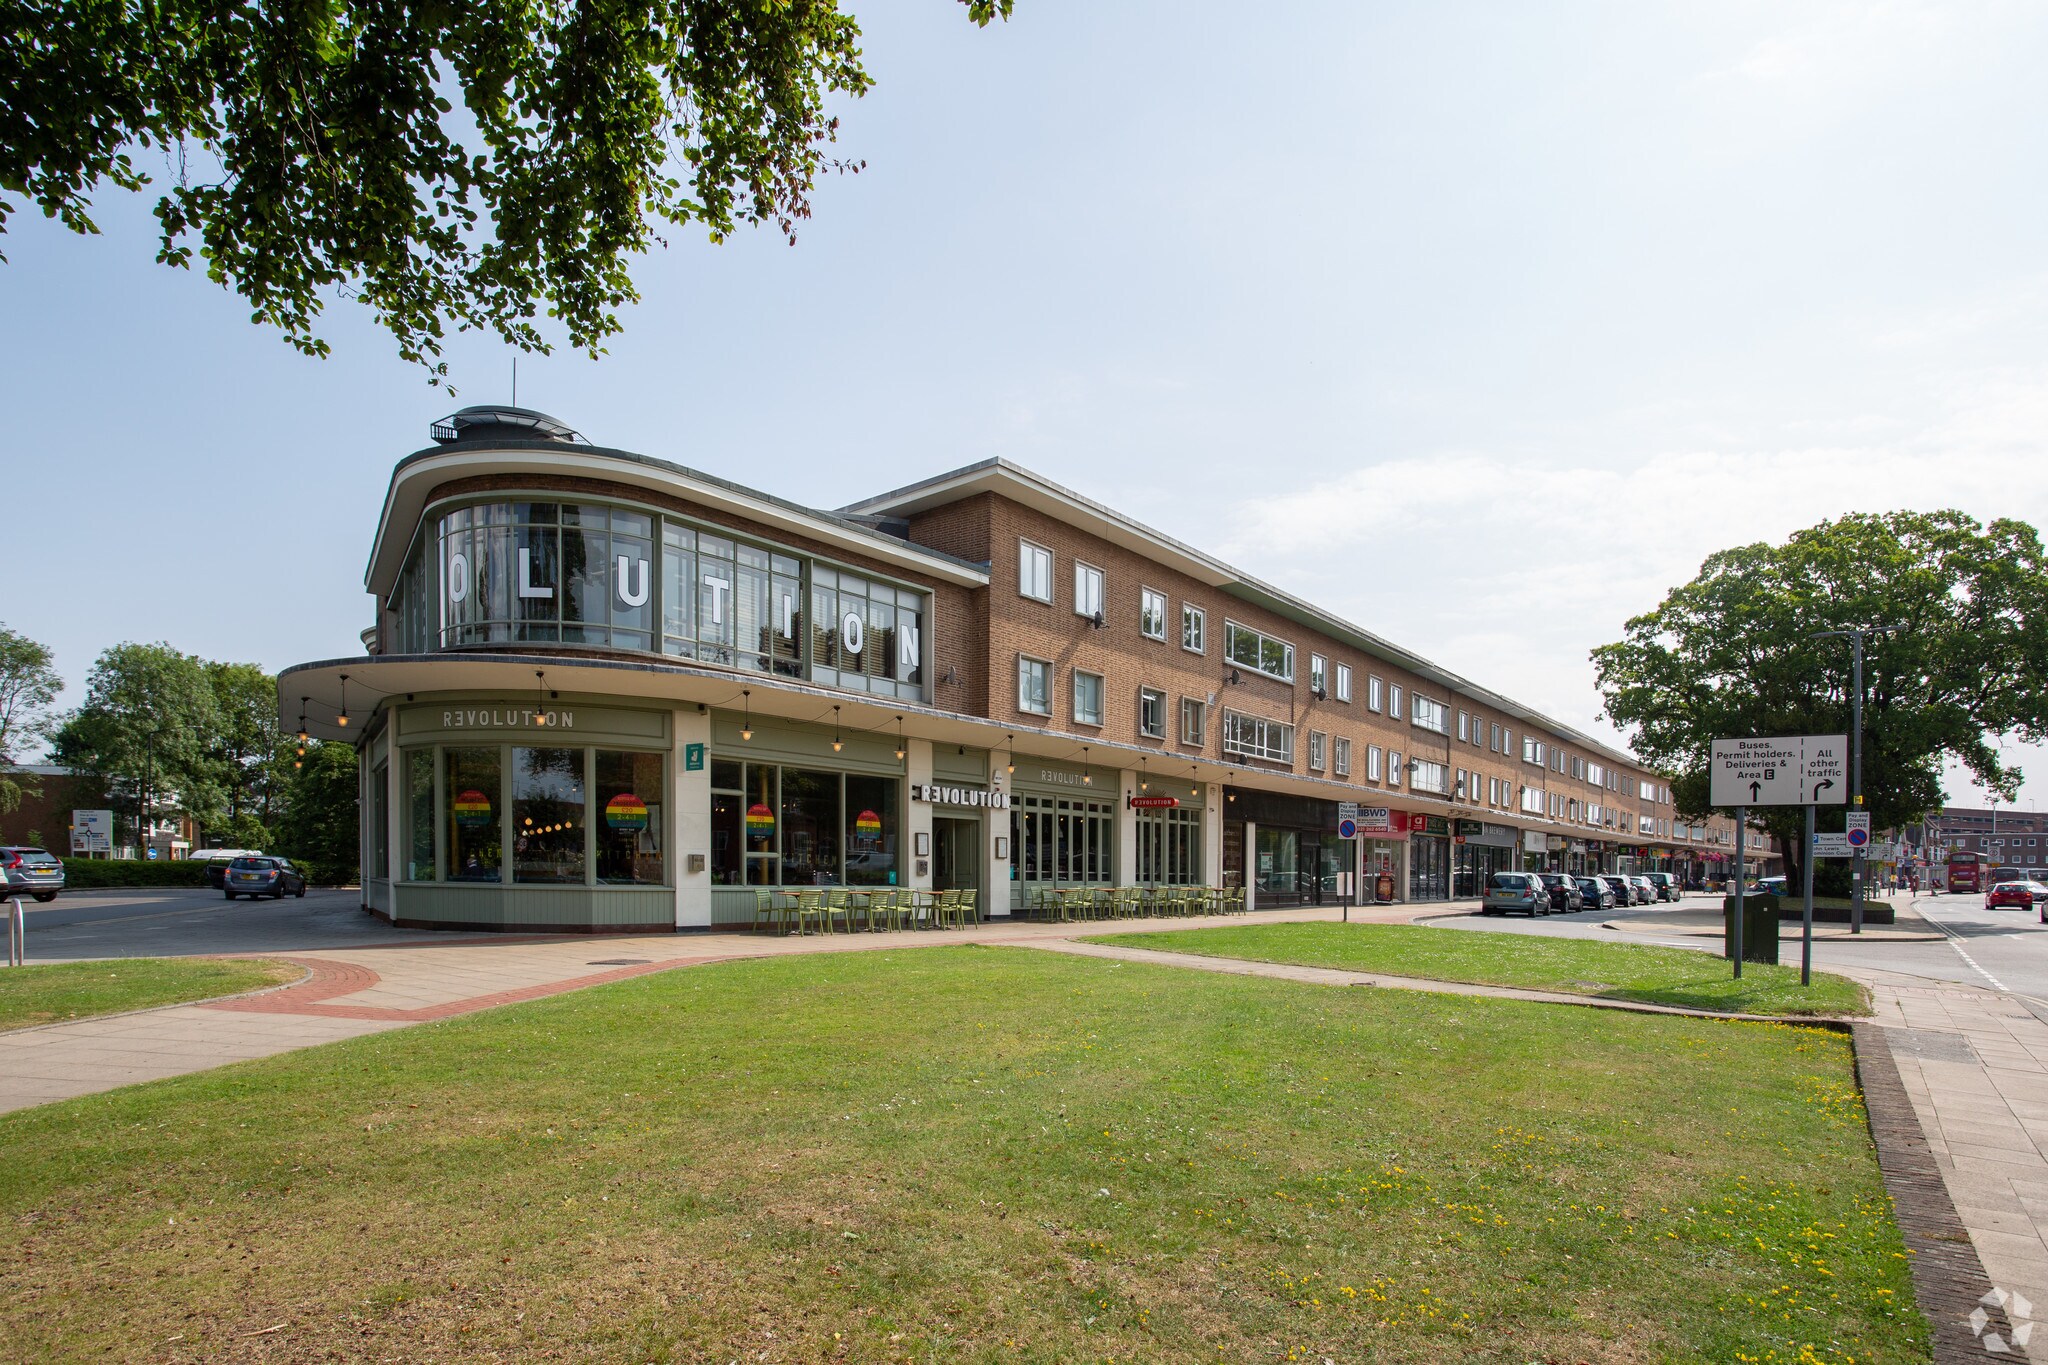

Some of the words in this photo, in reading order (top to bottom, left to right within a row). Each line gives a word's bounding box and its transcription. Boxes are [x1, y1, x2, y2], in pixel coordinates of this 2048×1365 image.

[443, 710, 573, 728] REVOLUTON
[1739, 741, 1773, 750] Buses.
[1716, 751, 1751, 760] Permit
[1753, 750, 1796, 758] holders.
[1817, 749, 1832, 758] All
[1725, 760, 1776, 769] Deliveries
[1779, 760, 1787, 768] &
[1810, 759, 1839, 768] other
[1737, 771, 1761, 779] Area
[1807, 769, 1842, 778] traffic
[920, 784, 1011, 810] REVOLUTION
